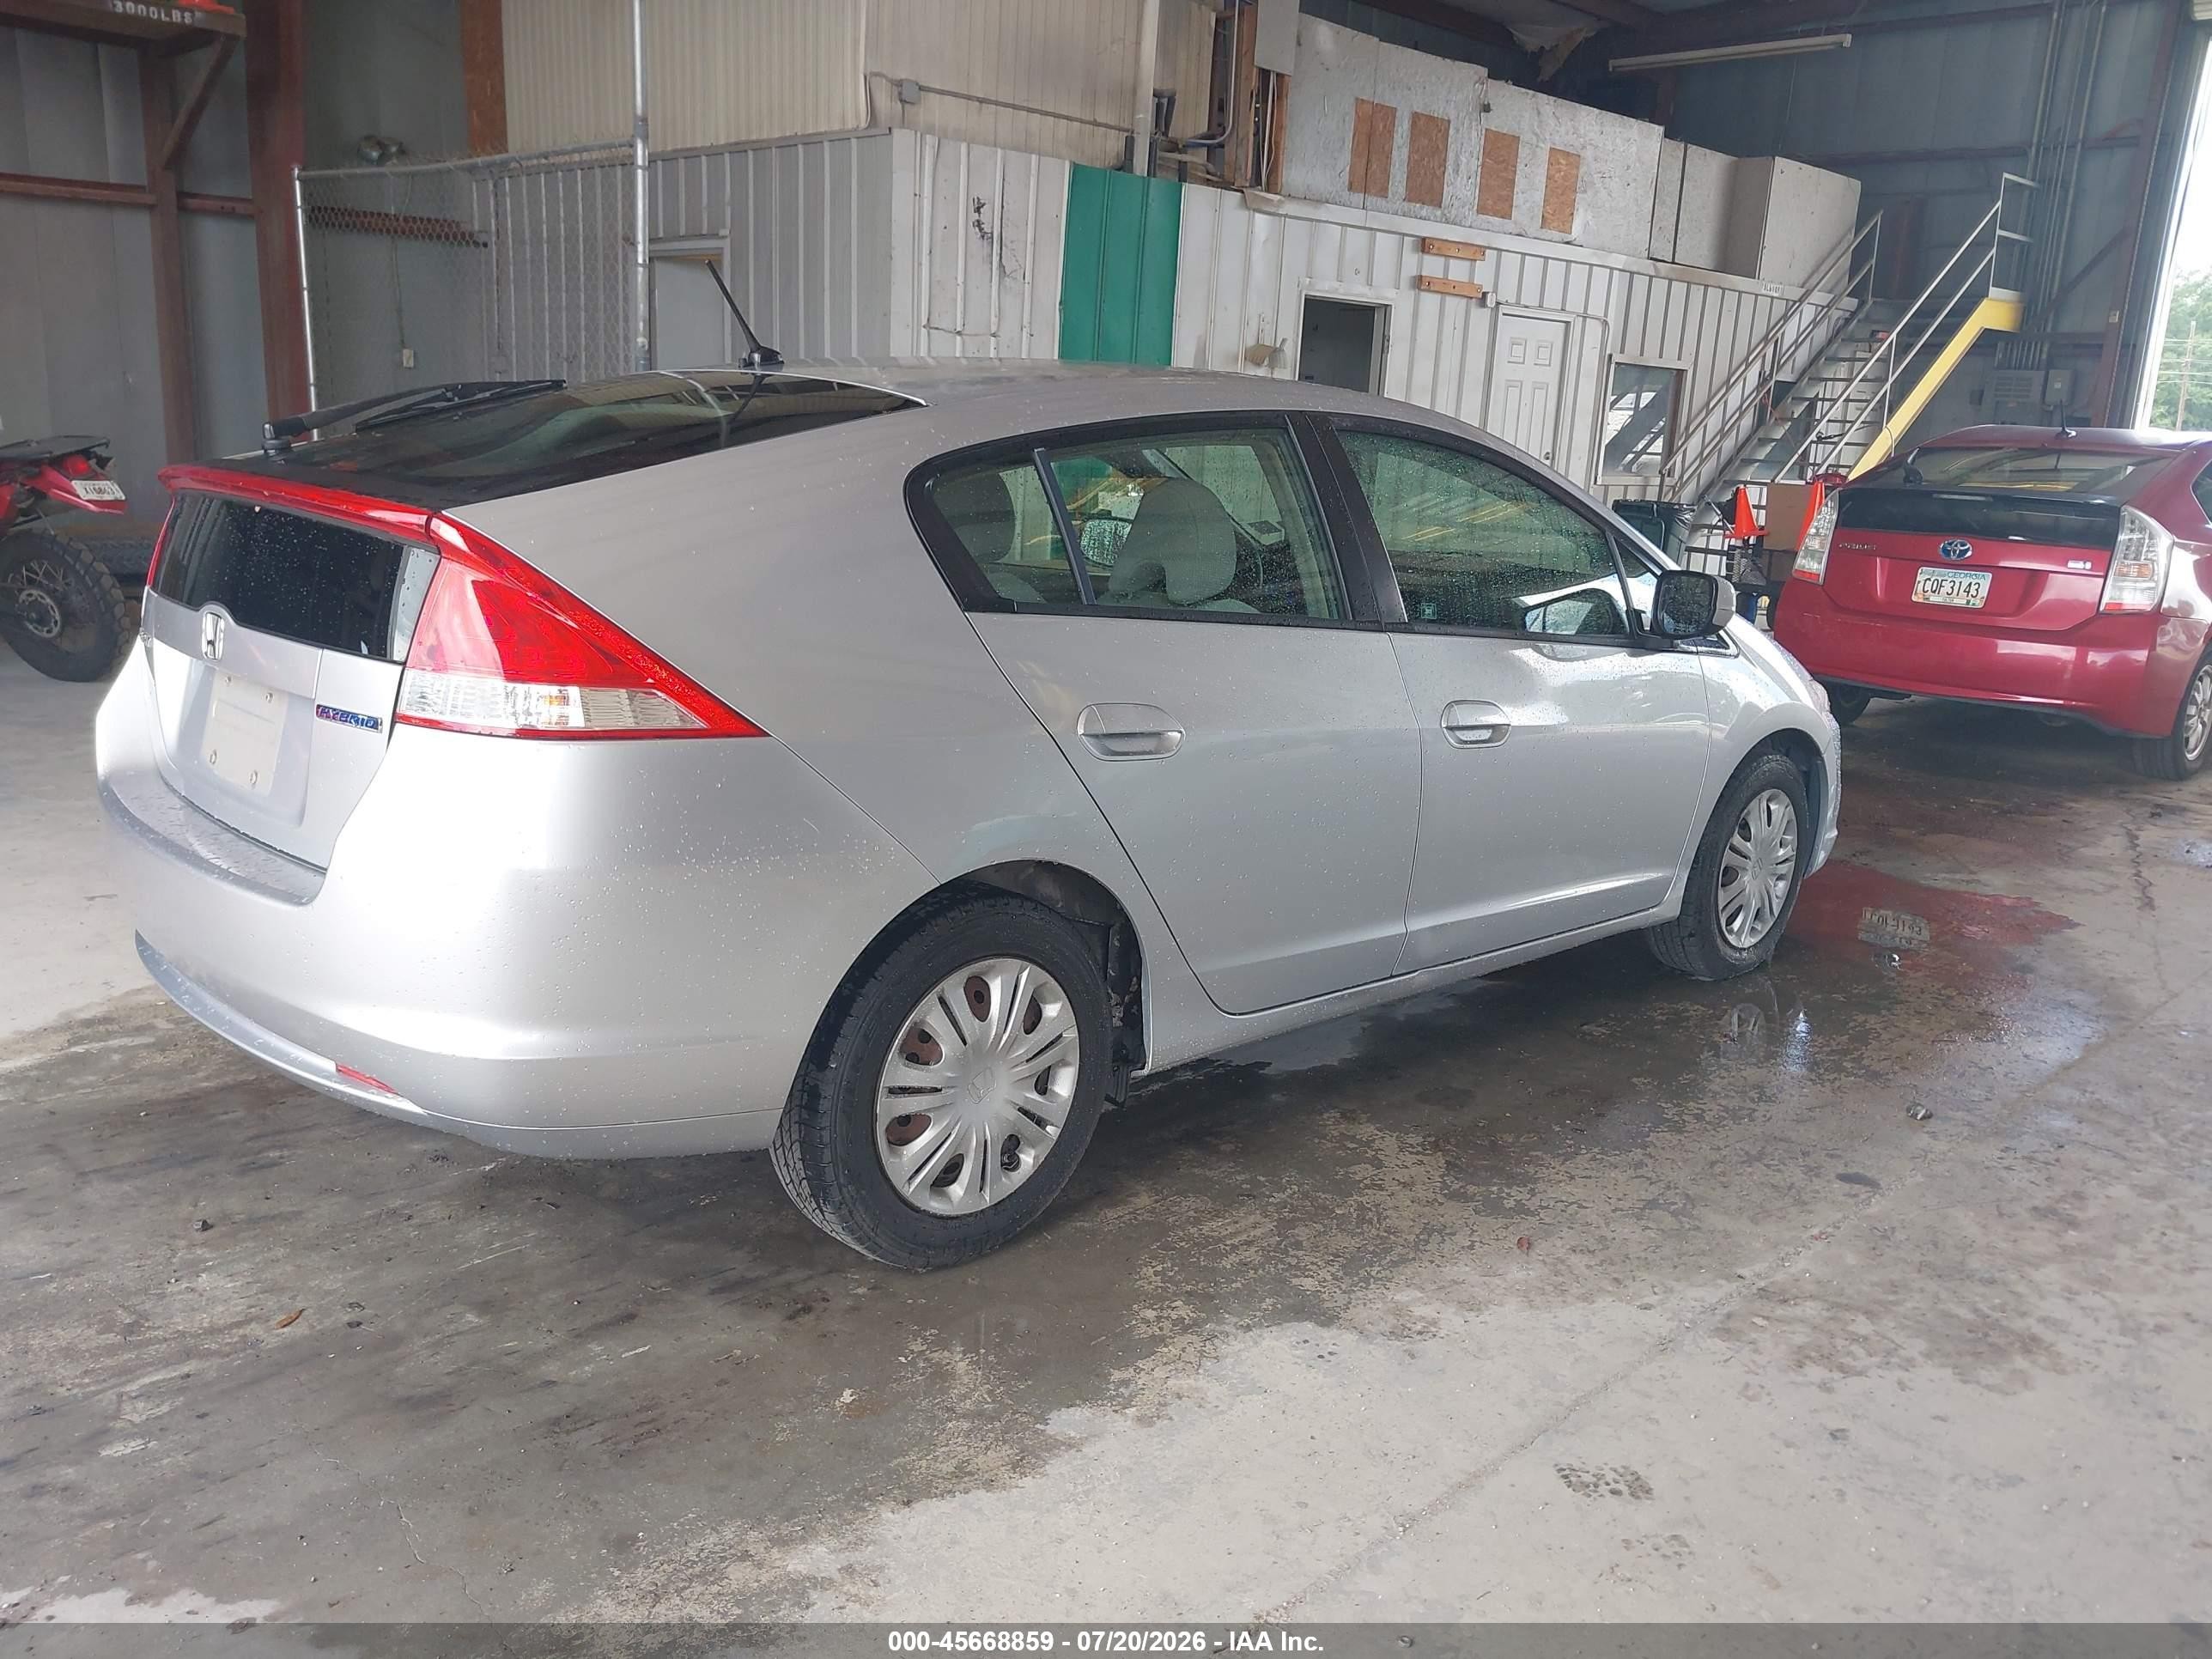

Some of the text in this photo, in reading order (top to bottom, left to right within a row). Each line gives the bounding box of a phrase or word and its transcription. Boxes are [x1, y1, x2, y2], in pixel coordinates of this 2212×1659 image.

[1947, 571, 1986, 581] GEORGIA
[1922, 577, 1981, 599] CQF3143
[318, 706, 376, 729] HYBRID
